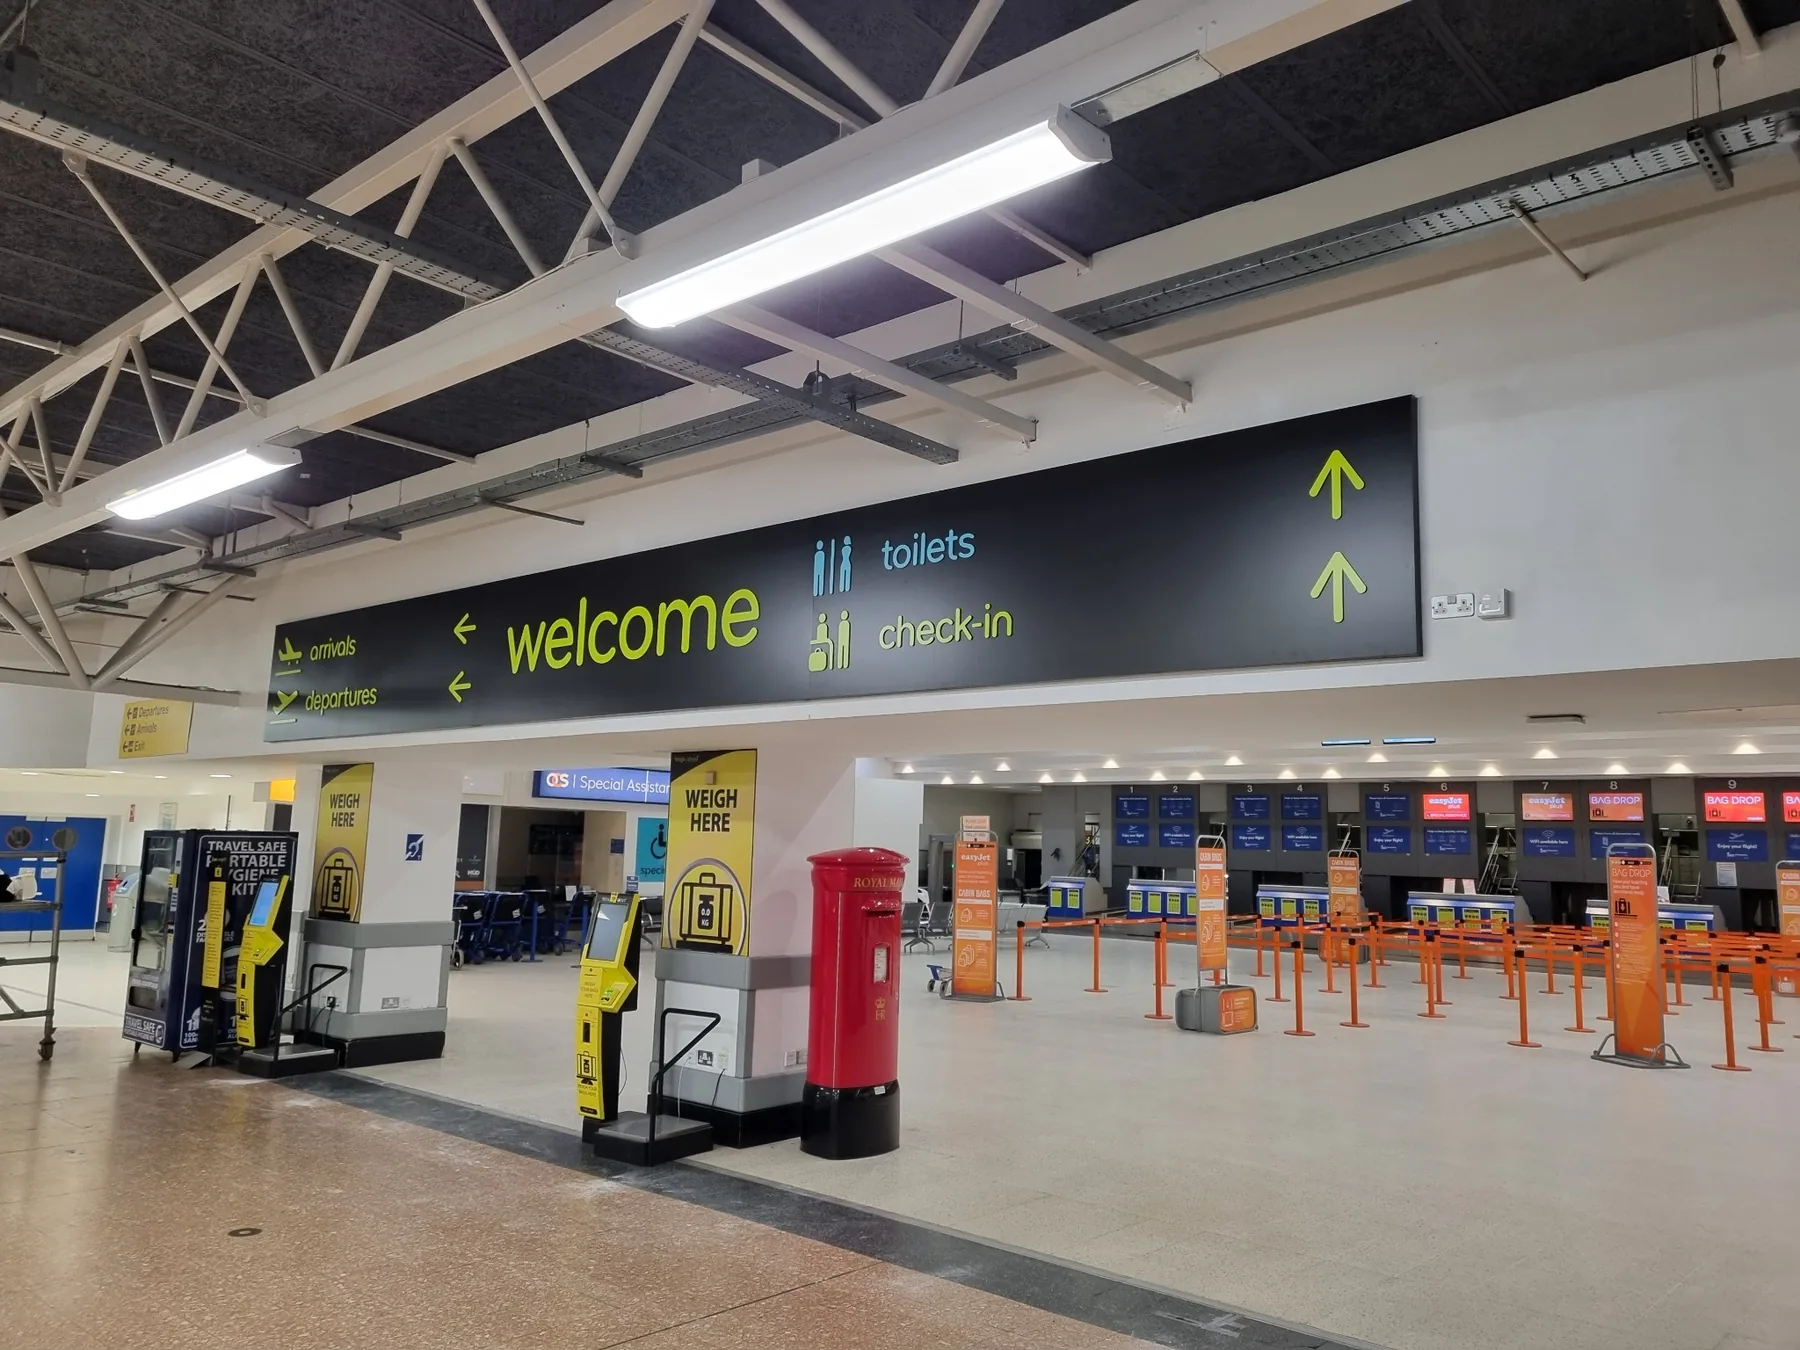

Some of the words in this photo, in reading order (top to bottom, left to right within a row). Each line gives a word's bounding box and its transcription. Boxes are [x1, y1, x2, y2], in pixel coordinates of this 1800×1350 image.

[882, 529, 974, 570] toilets
[508, 588, 760, 674] welcome
[879, 603, 1013, 650] check-in
[310, 634, 356, 661] arrivals
[305, 686, 378, 715] departures
[138, 705, 169, 718] Departures
[136, 722, 157, 734] Arrivals
[134, 741, 145, 752] Exit
[580, 776, 623, 792] Special
[626, 778, 670, 794] Assista
[1542, 782, 1549, 790] 7
[1610, 781, 1618, 790] 8
[1728, 780, 1737, 789] 9
[330, 794, 360, 809] WEIGH
[686, 788, 738, 808] WEIGH
[1428, 797, 1463, 805] easyJet
[1707, 796, 1729, 804] BAG
[1732, 796, 1761, 804] DROP
[1786, 796, 1800, 804] BA
[331, 812, 355, 827] HERE
[690, 813, 730, 832] HERE
[208, 841, 254, 852] TRAVEL
[257, 841, 287, 852] SAFE
[206, 855, 286, 867] PRTABLE
[229, 869, 279, 881] GIENE
[640, 868, 664, 876] speci
[1613, 868, 1628, 877] BAG
[1629, 869, 1650, 877] DROP
[854, 877, 887, 887] ROYAL
[890, 878, 904, 888] MA
[232, 882, 257, 896] KIT
[958, 889, 974, 897] CABIN
[976, 890, 990, 898] BAGS
[701, 908, 711, 917] 0.0
[126, 1016, 142, 1029] TRAVEL
[143, 1020, 155, 1033] SAFE
